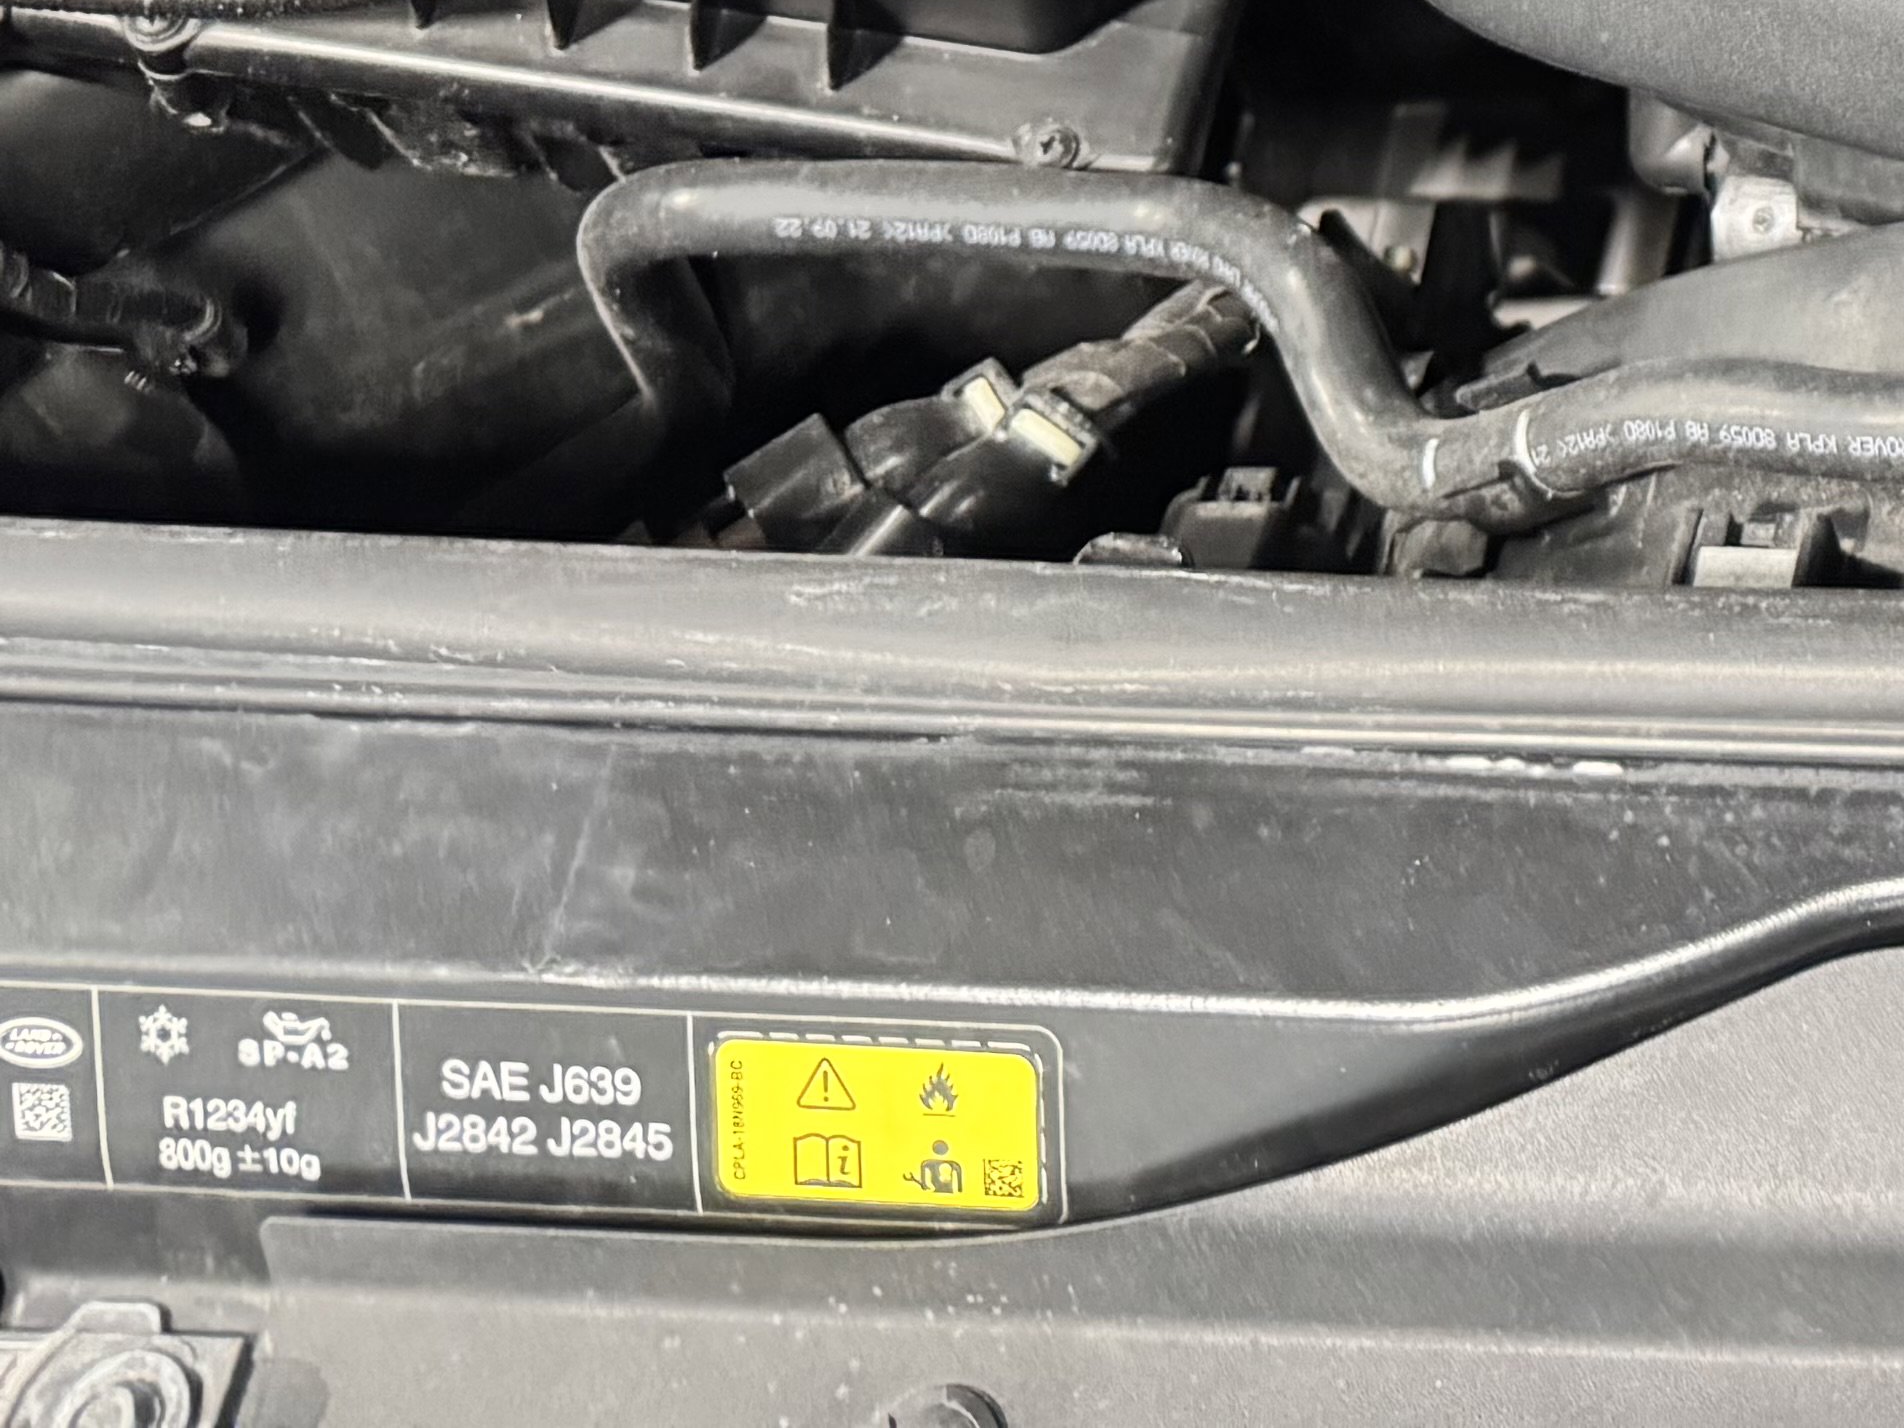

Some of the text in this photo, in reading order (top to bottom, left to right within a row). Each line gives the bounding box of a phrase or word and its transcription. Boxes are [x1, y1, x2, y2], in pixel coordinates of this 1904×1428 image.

[441, 1058, 642, 1106] SAE J639
[162, 1095, 297, 1141] R1234yf
[412, 1111, 674, 1162] J2842 J2845
[158, 1136, 232, 1178] 800g
